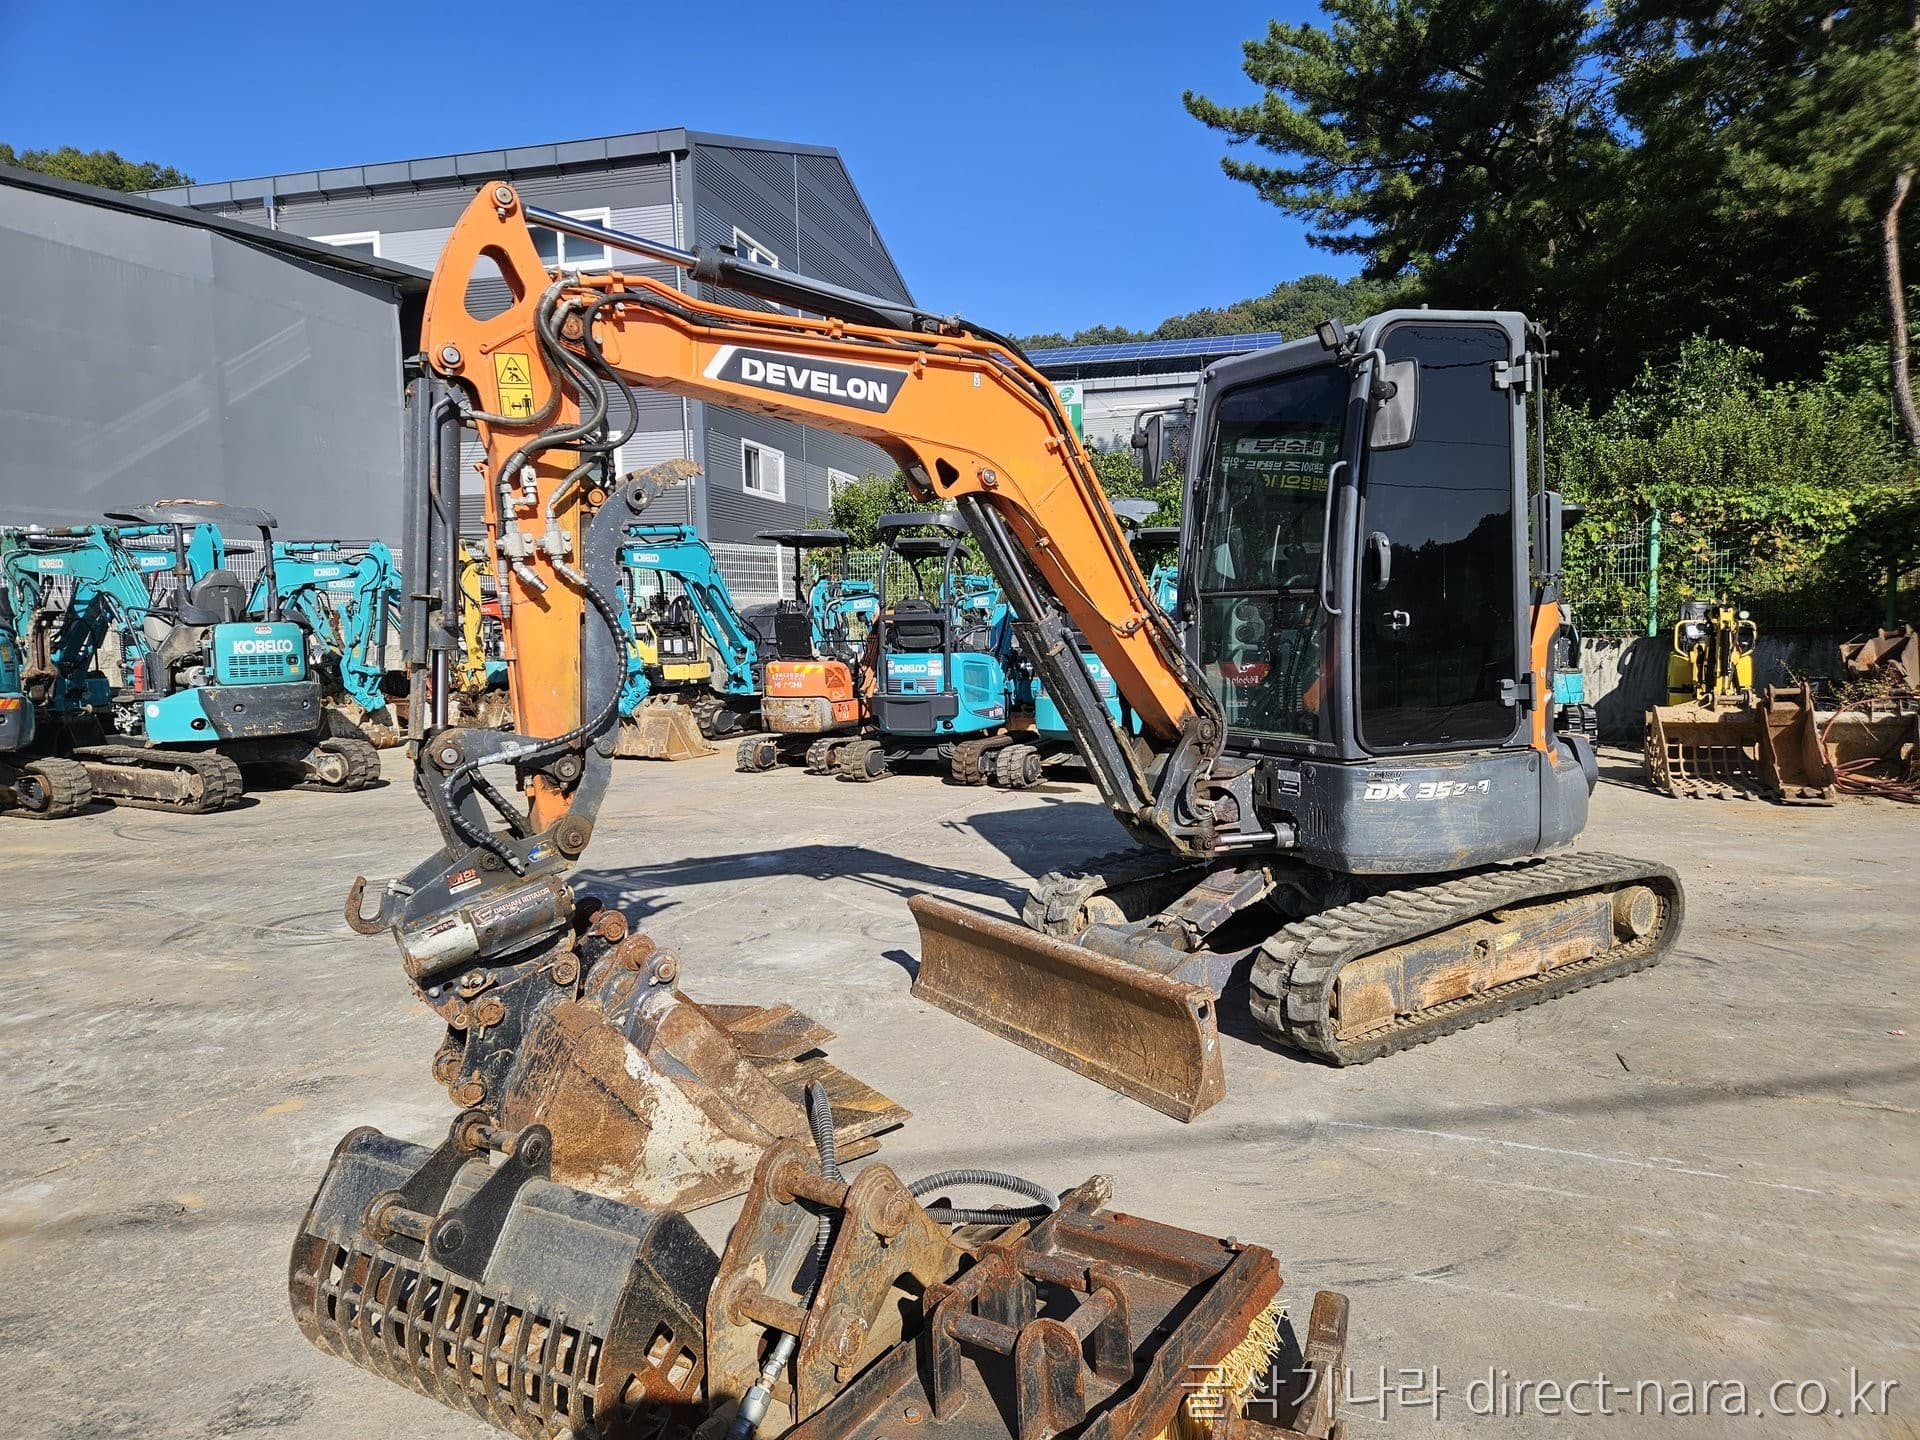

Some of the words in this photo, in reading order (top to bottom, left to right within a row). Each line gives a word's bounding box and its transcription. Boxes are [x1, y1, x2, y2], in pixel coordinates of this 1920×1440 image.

[741, 357, 888, 404] DEVELON
[233, 639, 294, 655] KOBELCO
[894, 663, 928, 674] KOBELCO
[1364, 782, 1411, 802] DX
[493, 898, 522, 914] DAEHAN
[522, 887, 551, 903] ROTATOR
